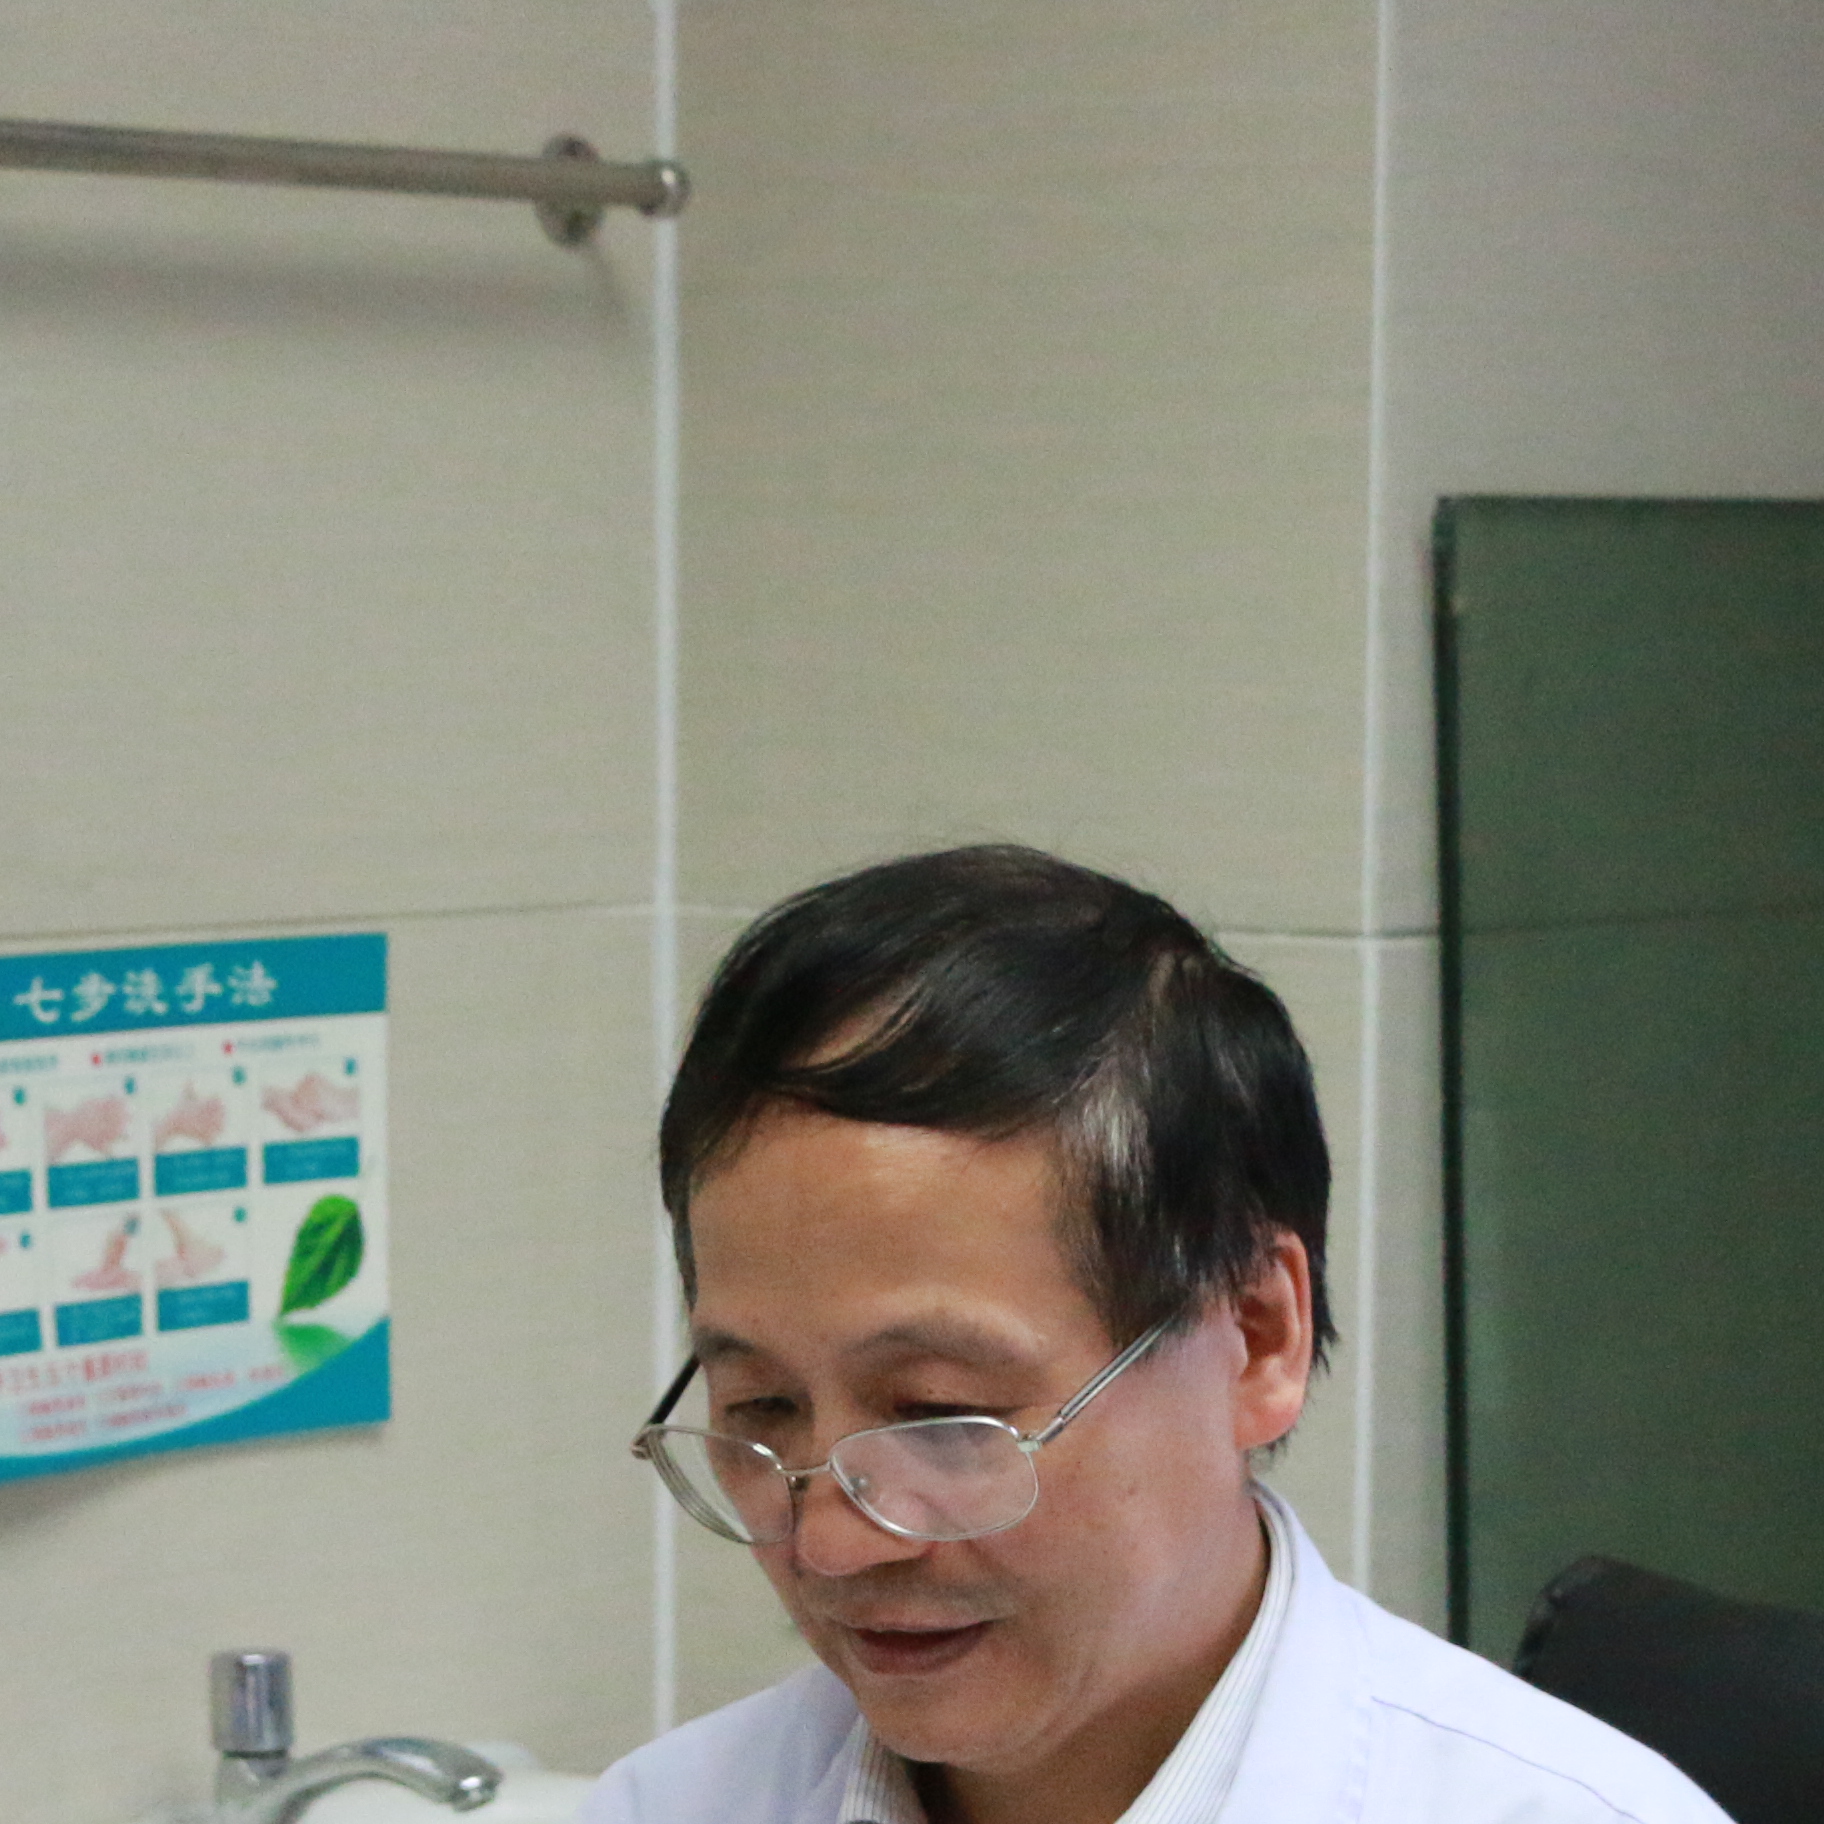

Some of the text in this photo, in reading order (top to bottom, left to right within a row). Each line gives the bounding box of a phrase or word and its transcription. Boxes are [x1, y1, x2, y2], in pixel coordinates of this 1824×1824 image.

[13, 960, 278, 1024] 七步洗手法
